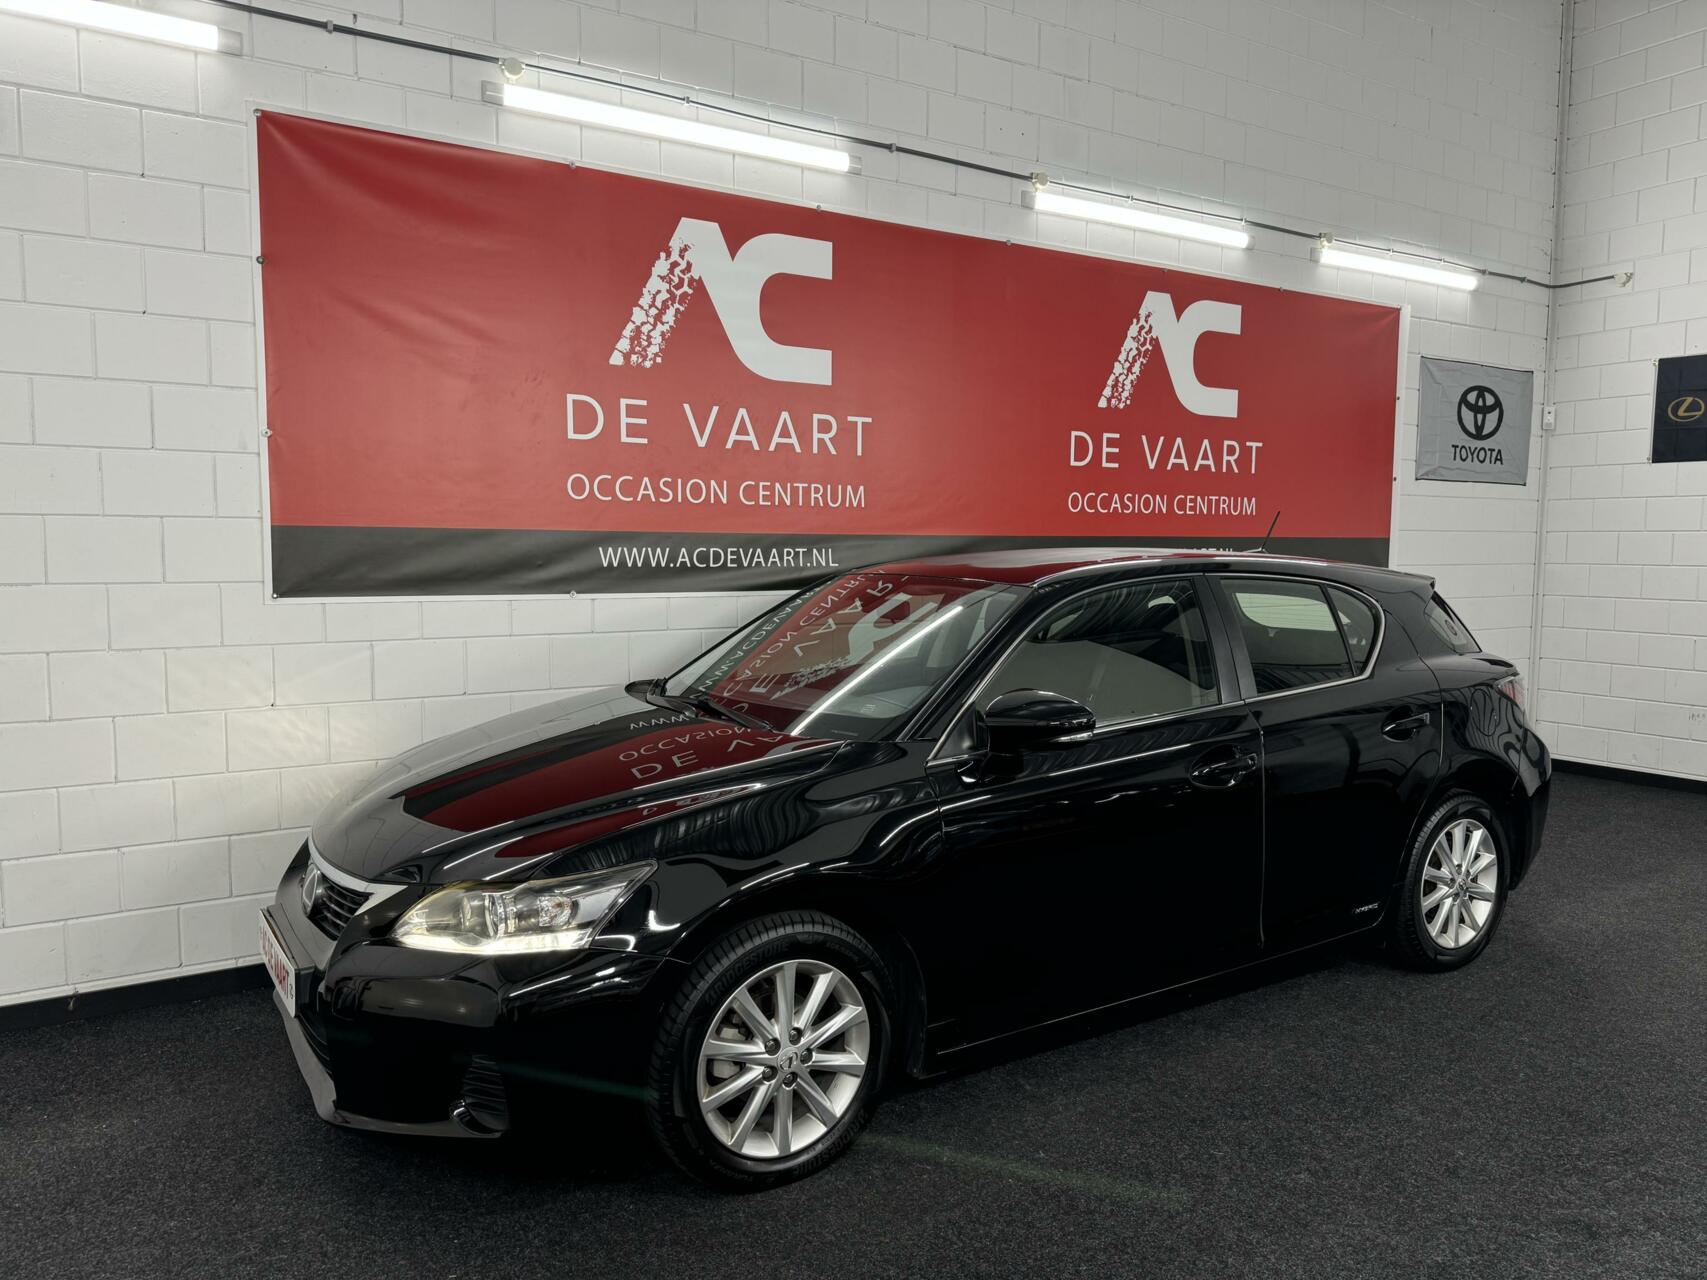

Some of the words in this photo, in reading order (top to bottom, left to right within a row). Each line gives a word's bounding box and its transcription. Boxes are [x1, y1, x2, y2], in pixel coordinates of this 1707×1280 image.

[608, 217, 833, 385] AC
[1097, 290, 1242, 418] AC
[566, 393, 648, 444] DE
[682, 403, 872, 456] VAART
[1069, 430, 1120, 468] DE
[1141, 434, 1263, 474] VAART
[1451, 444, 1504, 465] TOYOTA
[566, 473, 728, 505] OCCASION
[738, 481, 865, 508] CENTRUM
[1068, 491, 1167, 514] OCCASION
[1173, 494, 1256, 516] CENTRUM
[598, 546, 839, 568] WWW.ACDEVAART.NL
